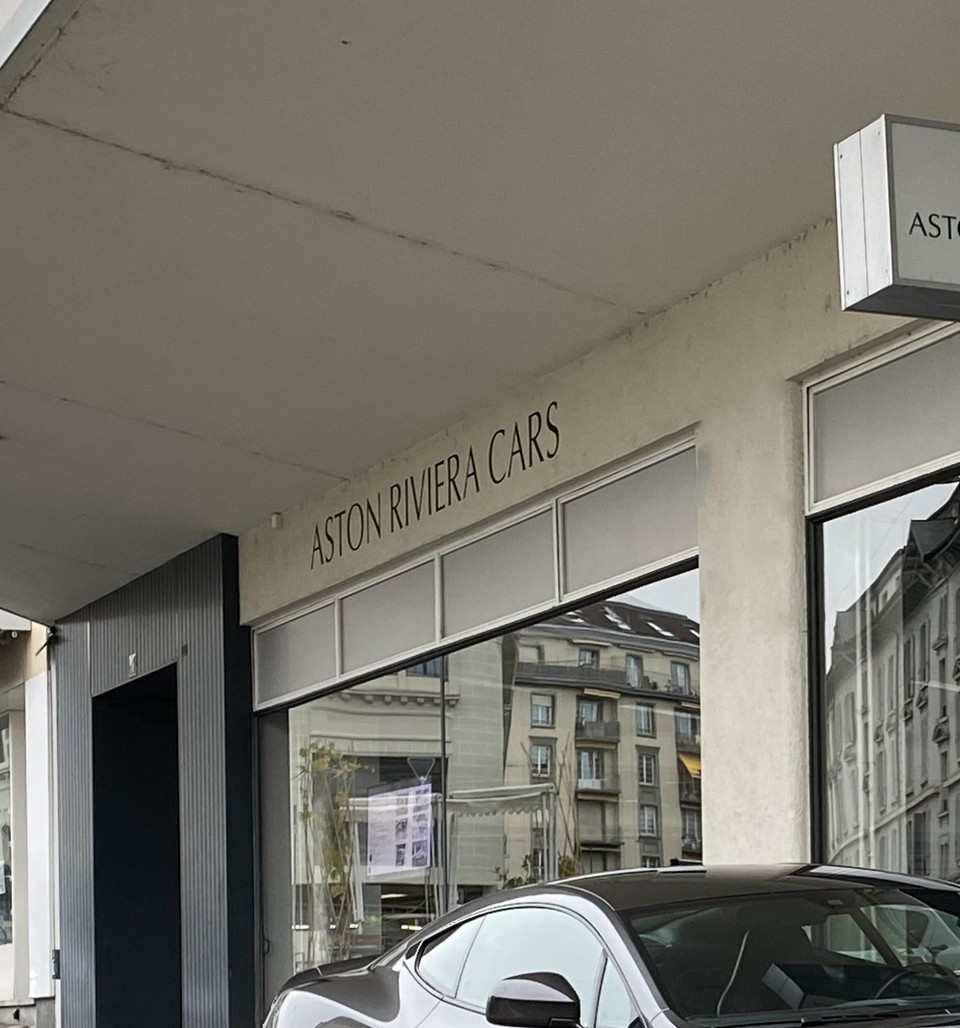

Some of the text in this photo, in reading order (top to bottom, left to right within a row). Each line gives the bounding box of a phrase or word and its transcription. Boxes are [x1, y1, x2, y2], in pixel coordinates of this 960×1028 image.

[310, 401, 560, 570] ASTON RIVIERA CARS
